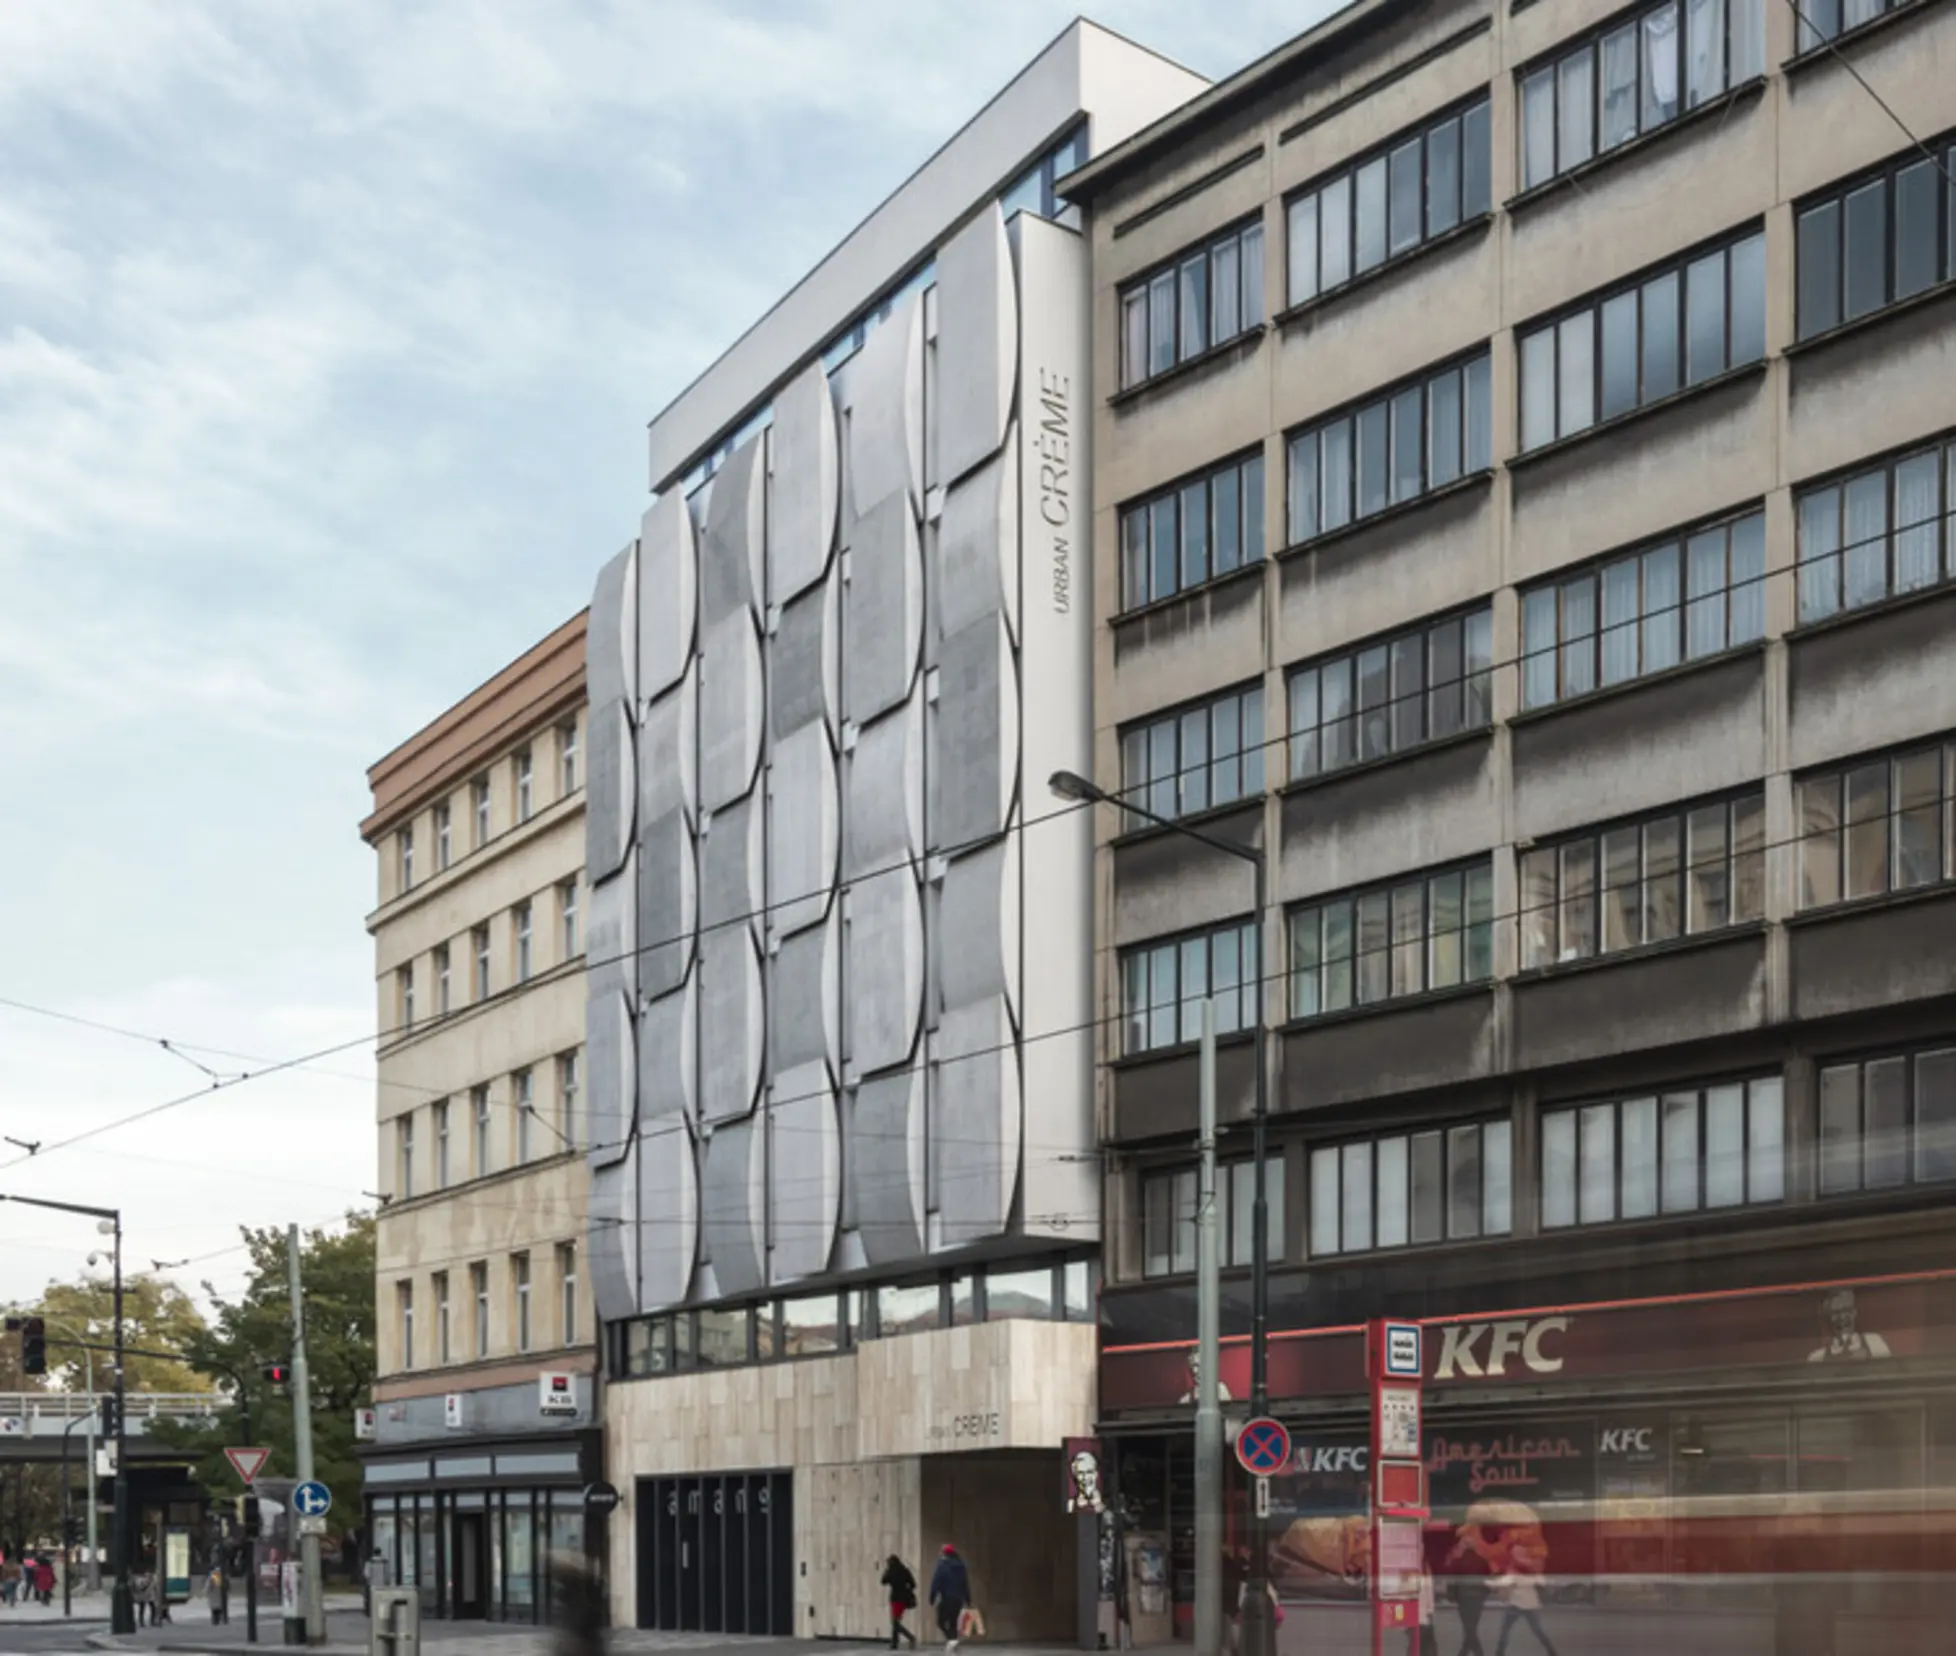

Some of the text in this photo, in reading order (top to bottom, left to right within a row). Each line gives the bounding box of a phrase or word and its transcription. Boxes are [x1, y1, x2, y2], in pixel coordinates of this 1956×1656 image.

[1053, 536, 1070, 615] URBAN
[1433, 1316, 1569, 1380] KFC
[1311, 1446, 1368, 1473] KFC
[1423, 1433, 1581, 1472] American
[1600, 1428, 1653, 1454] KFC
[1468, 1458, 1540, 1493] Soul
